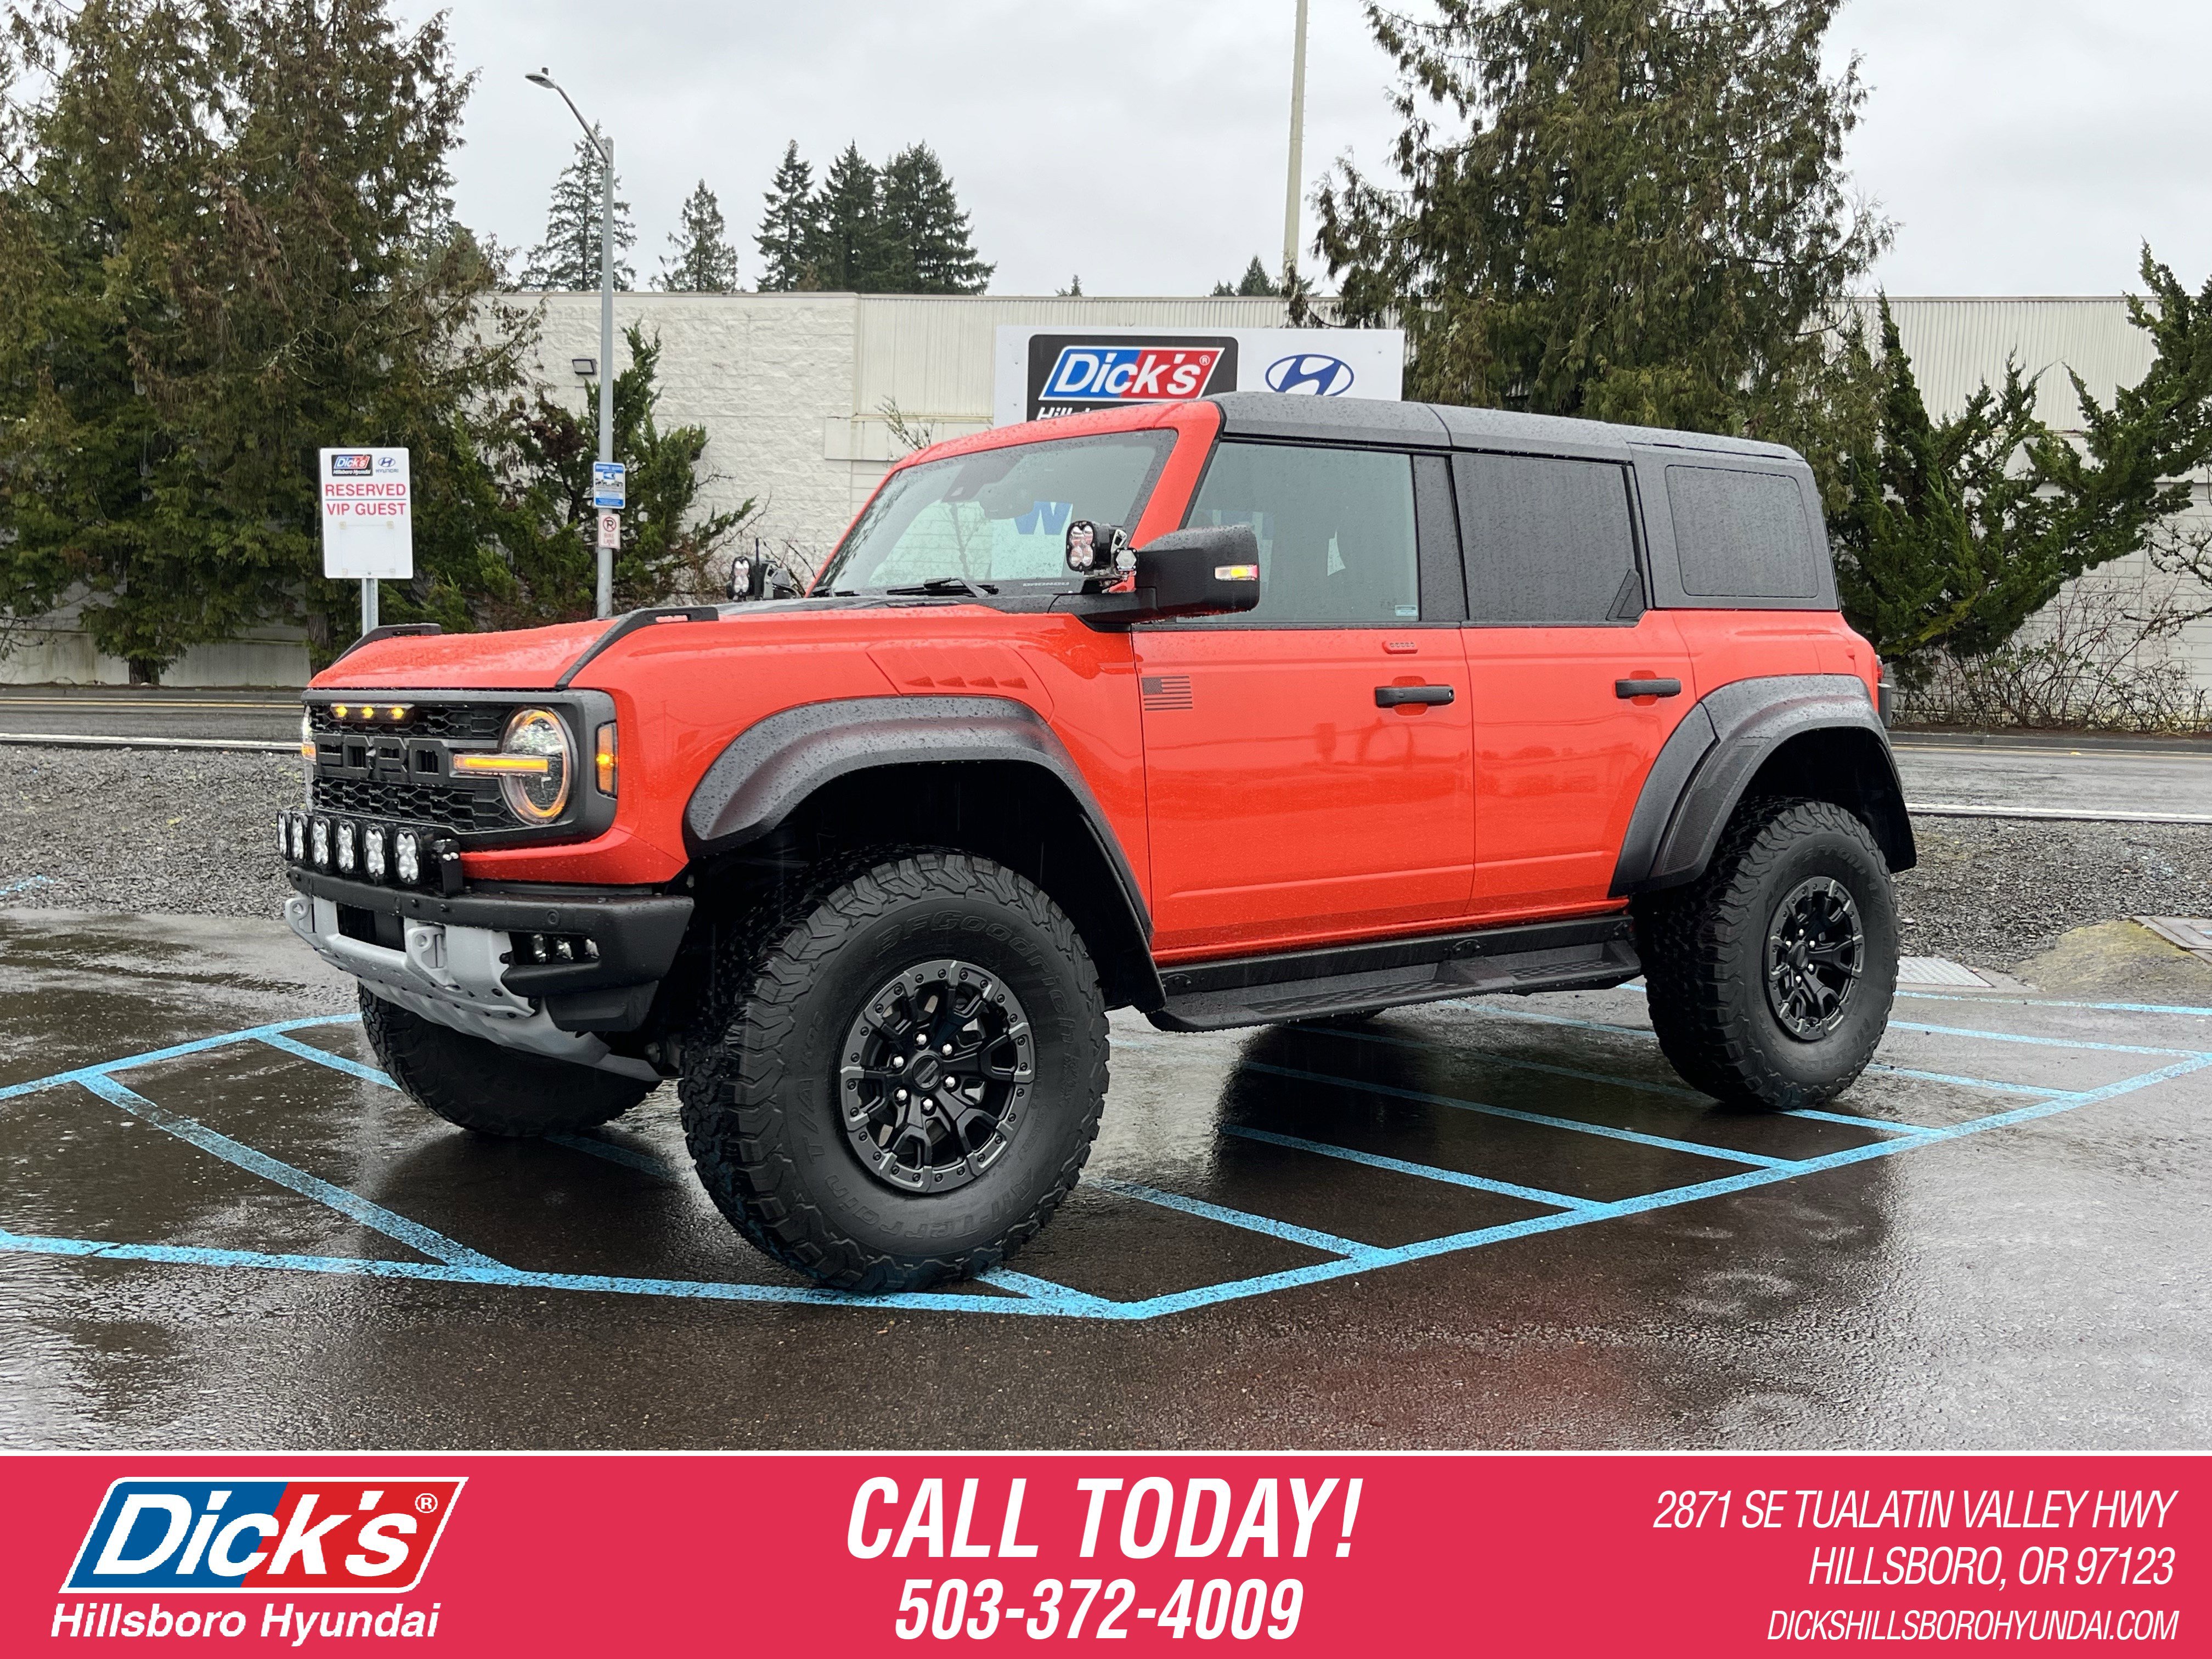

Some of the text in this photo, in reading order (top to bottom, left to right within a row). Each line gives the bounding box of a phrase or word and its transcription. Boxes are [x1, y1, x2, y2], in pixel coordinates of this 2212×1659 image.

[1053, 352, 1201, 395] Dick's
[325, 483, 406, 496] RESERVED
[326, 503, 407, 515] VIP GUEST
